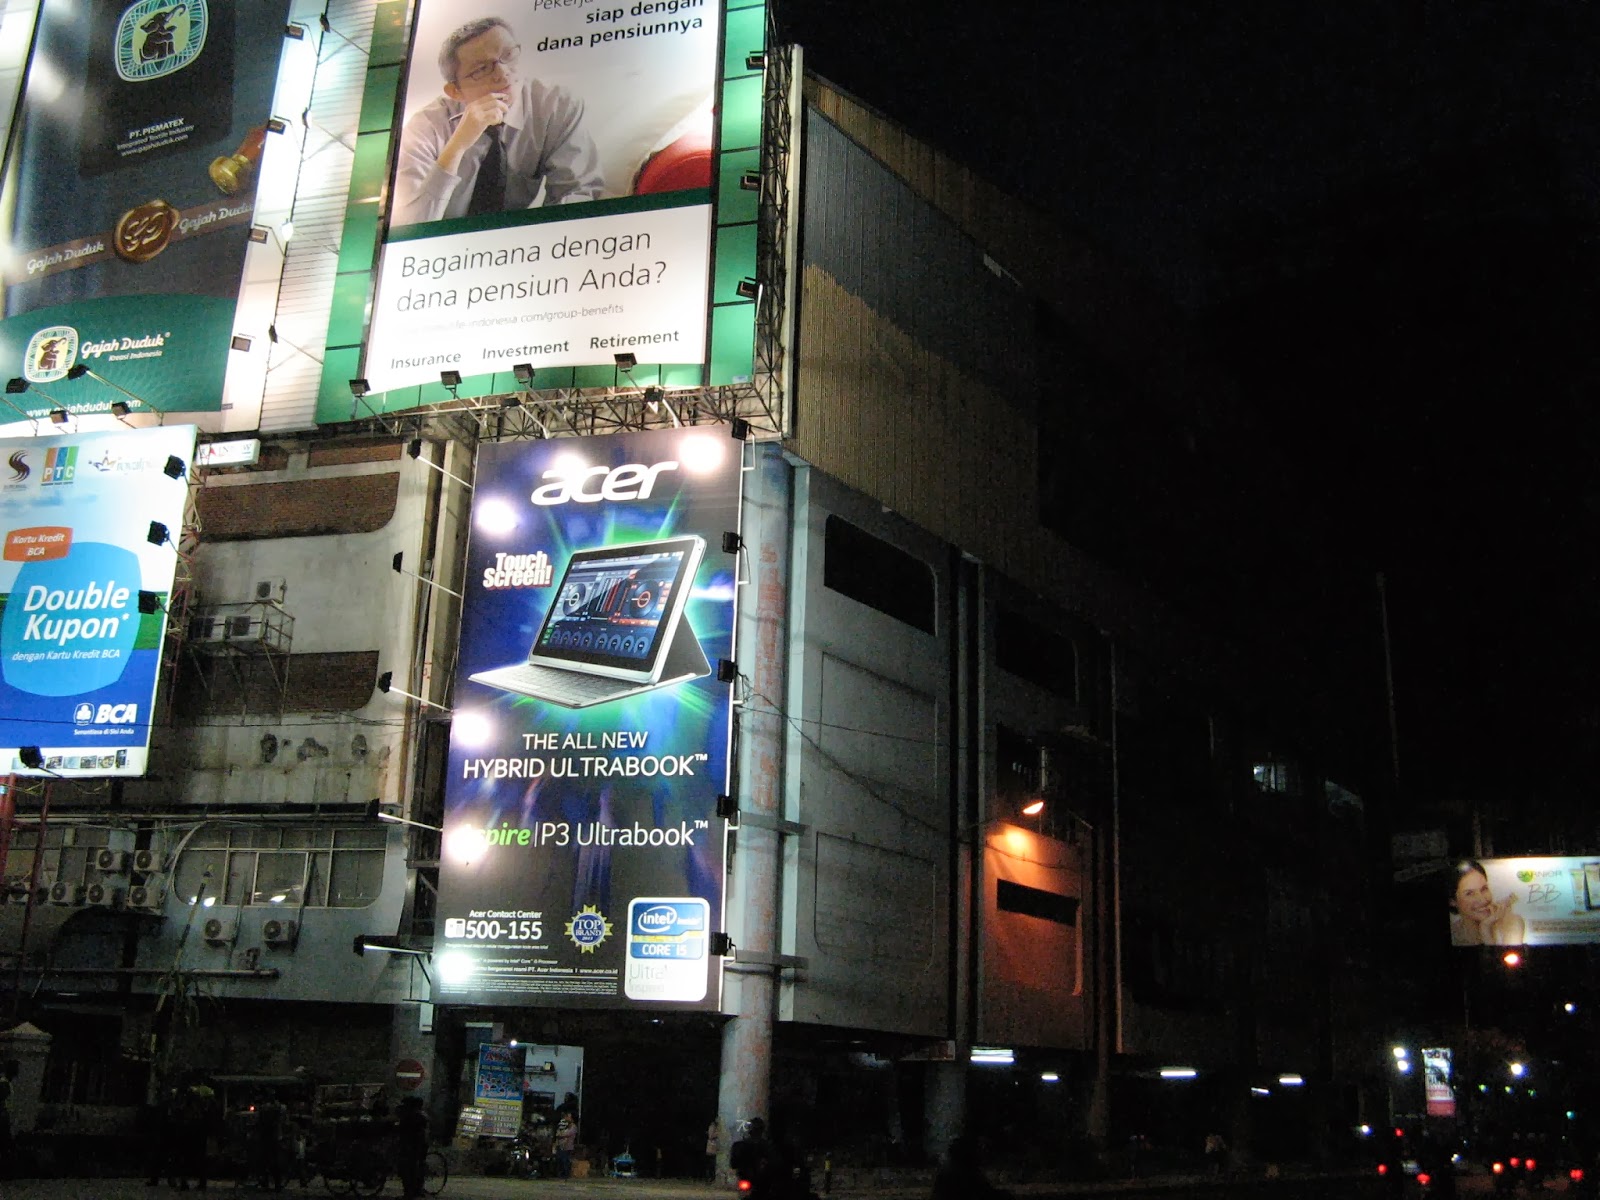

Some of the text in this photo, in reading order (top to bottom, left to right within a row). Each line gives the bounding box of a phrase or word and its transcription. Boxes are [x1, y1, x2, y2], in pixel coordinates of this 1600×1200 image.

[586, 8, 624, 26] siap
[537, 16, 703, 52] dana pensiunnya
[142, 117, 185, 137] PISMATEX
[179, 211, 217, 234] Gajah
[27, 250, 65, 273] Gajah
[401, 231, 651, 280] Bagaimana dengan
[397, 261, 668, 312] dana pensiun Anda?
[81, 338, 120, 360] Gajah
[391, 330, 680, 370] Insurance Investment Retirement
[44, 465, 75, 481] PTC
[530, 460, 679, 505] acer
[12, 532, 65, 544] Kartu Kredit
[27, 546, 46, 556] BCA
[495, 551, 548, 572] Touch
[482, 565, 553, 589] Screen!
[23, 580, 130, 612] Double
[12, 648, 121, 662] dengan Kartu Kredit BCA
[94, 703, 138, 724] BCA
[522, 731, 648, 750] THE ALL NEW
[463, 758, 545, 779] HYBRID
[541, 823, 570, 846] P3
[1526, 883, 1562, 905] BB
[469, 910, 543, 920] Acer Contact Center
[576, 919, 602, 930] TOP
[465, 920, 543, 941] 500-155
